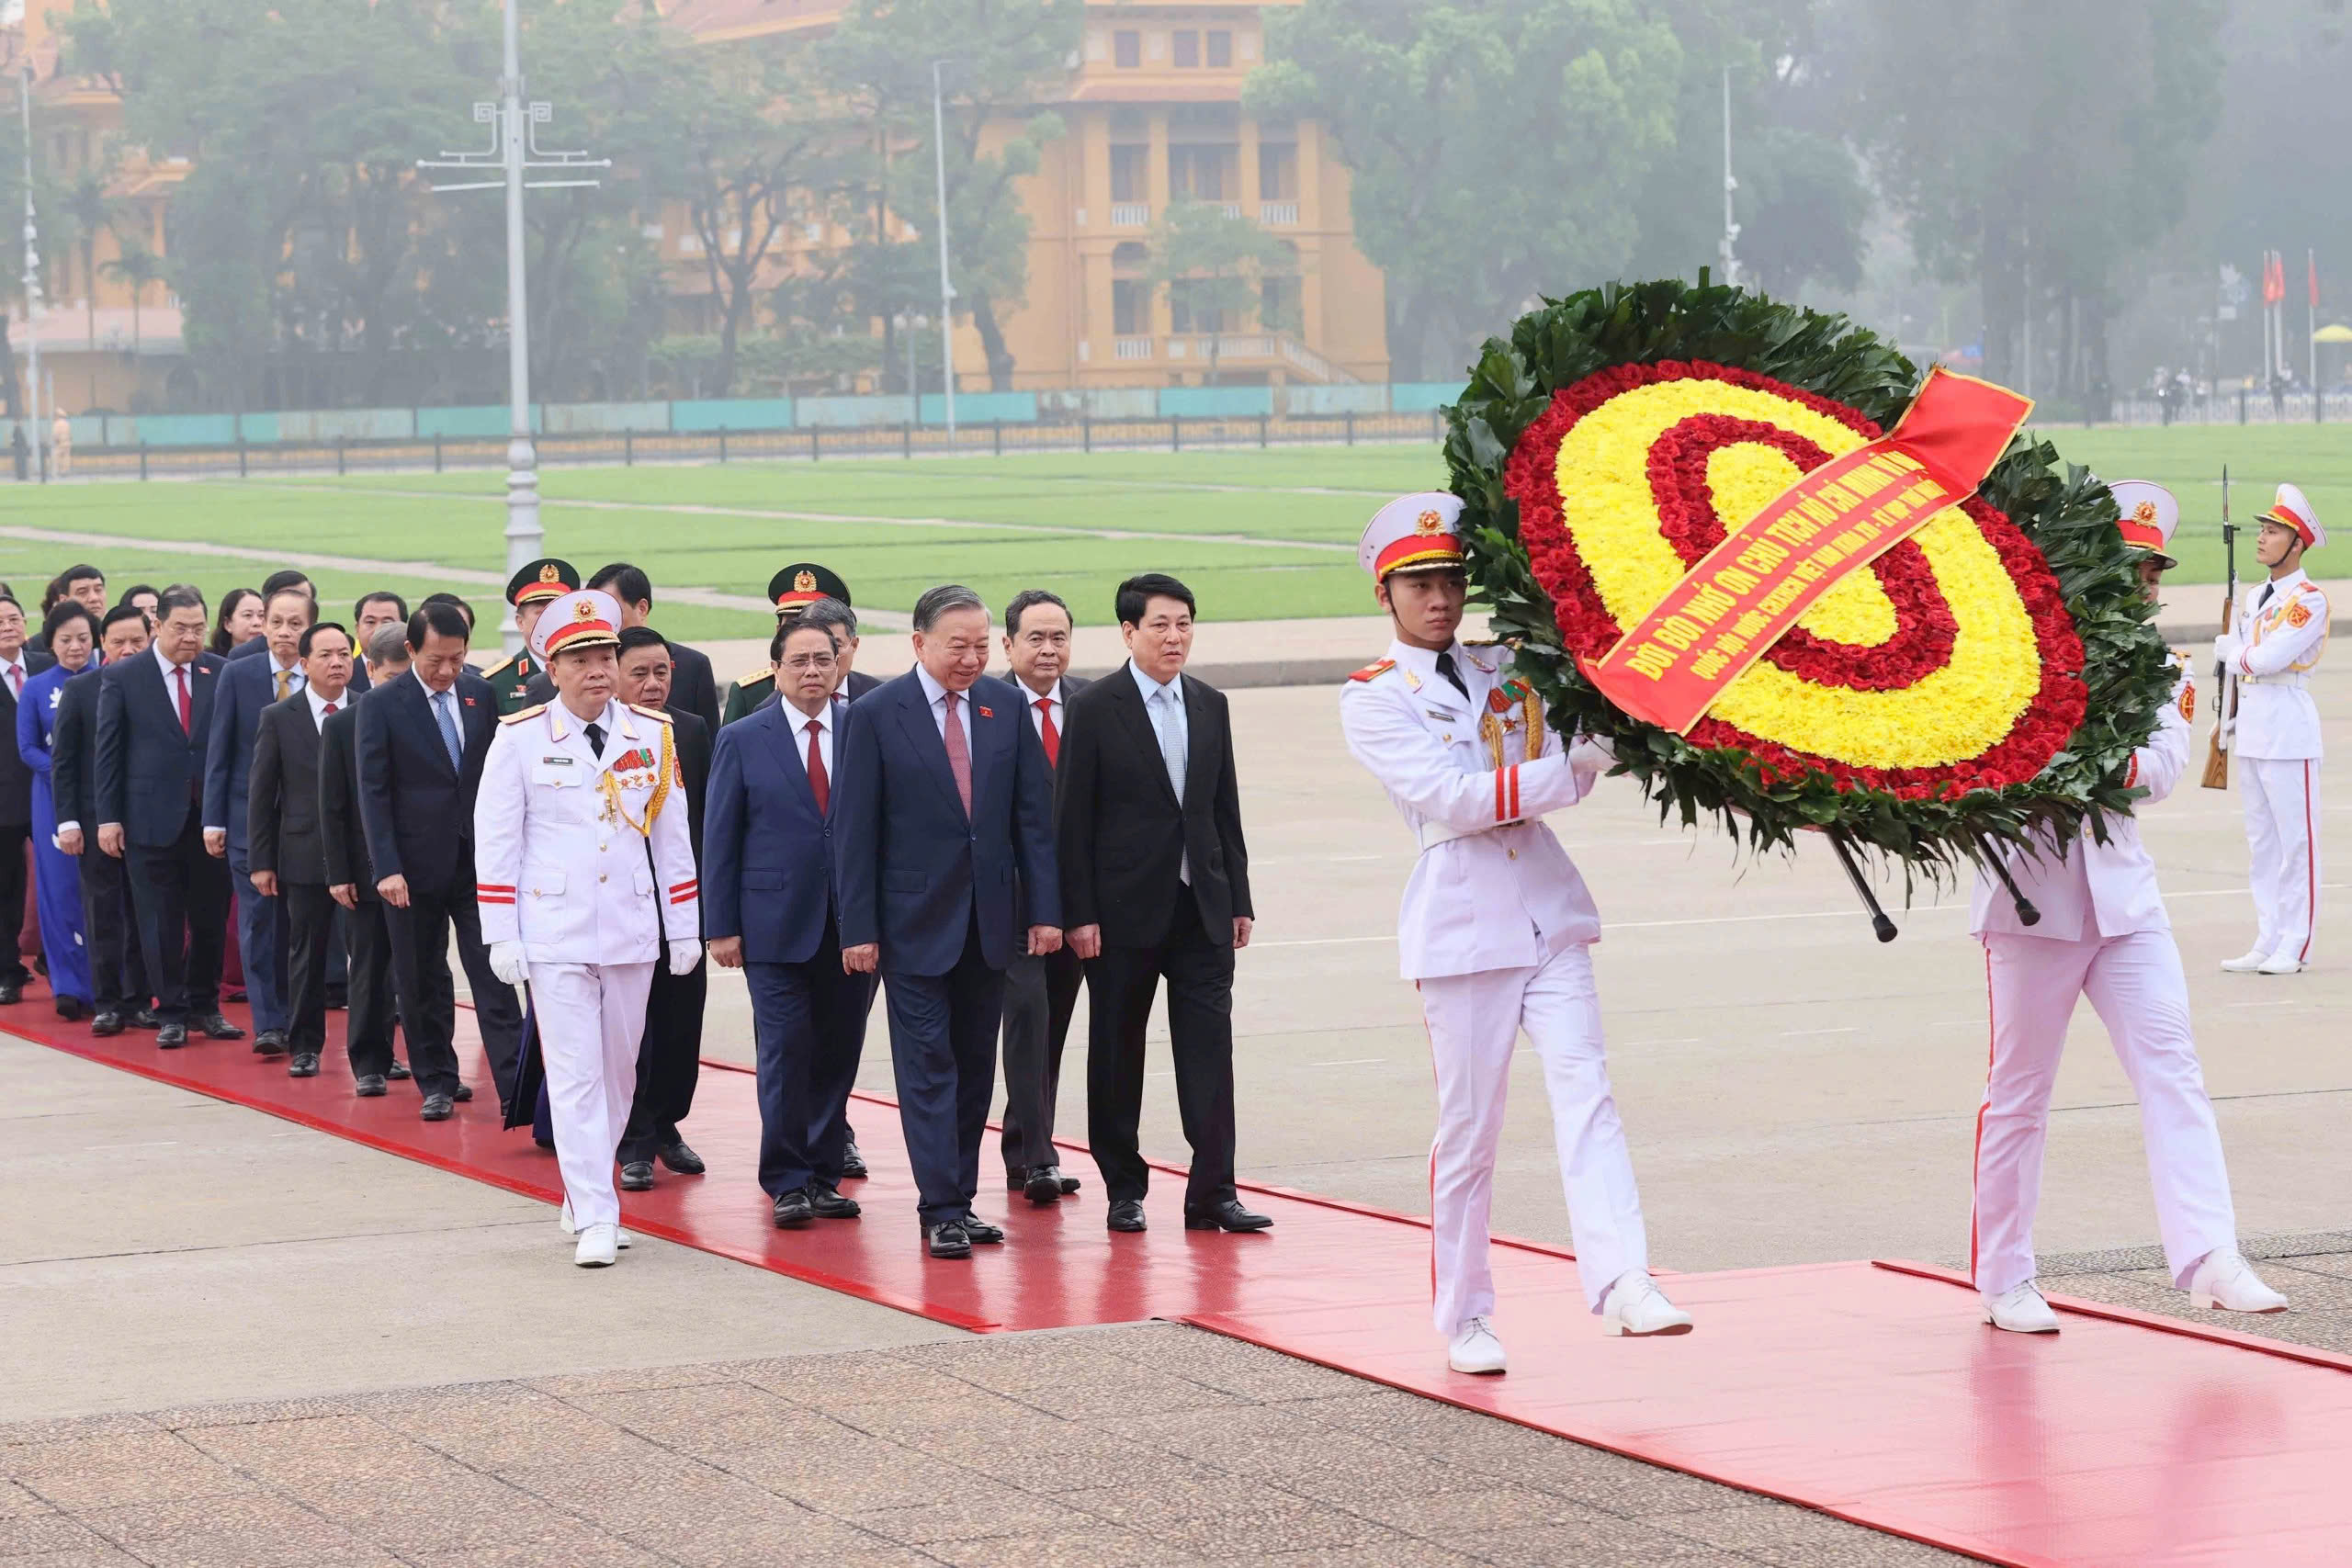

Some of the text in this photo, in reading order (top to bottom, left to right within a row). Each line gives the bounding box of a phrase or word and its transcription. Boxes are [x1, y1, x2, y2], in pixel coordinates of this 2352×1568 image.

[1837, 464, 1896, 499] MINH
[1868, 452, 1909, 477] VĨ
[1795, 490, 1839, 527] HỒ
[1815, 479, 1863, 513] CHÍ
[1764, 508, 1822, 547] TỊCH
[1736, 533, 1791, 574] CHỦ
[1791, 558, 1827, 582] VIỆT
[1810, 544, 1847, 568] NAM
[1713, 565, 1761, 595] ƠN
[1756, 575, 1809, 616] CHXHCN
[1679, 581, 1736, 626] NHỚ
[1652, 615, 1706, 652] ĐỜI
[1730, 610, 1772, 640] NƯỚC
[1624, 641, 1679, 682] ĐỜI
[1714, 633, 1748, 657] HỘI
[1690, 649, 1730, 681] QUỐC
